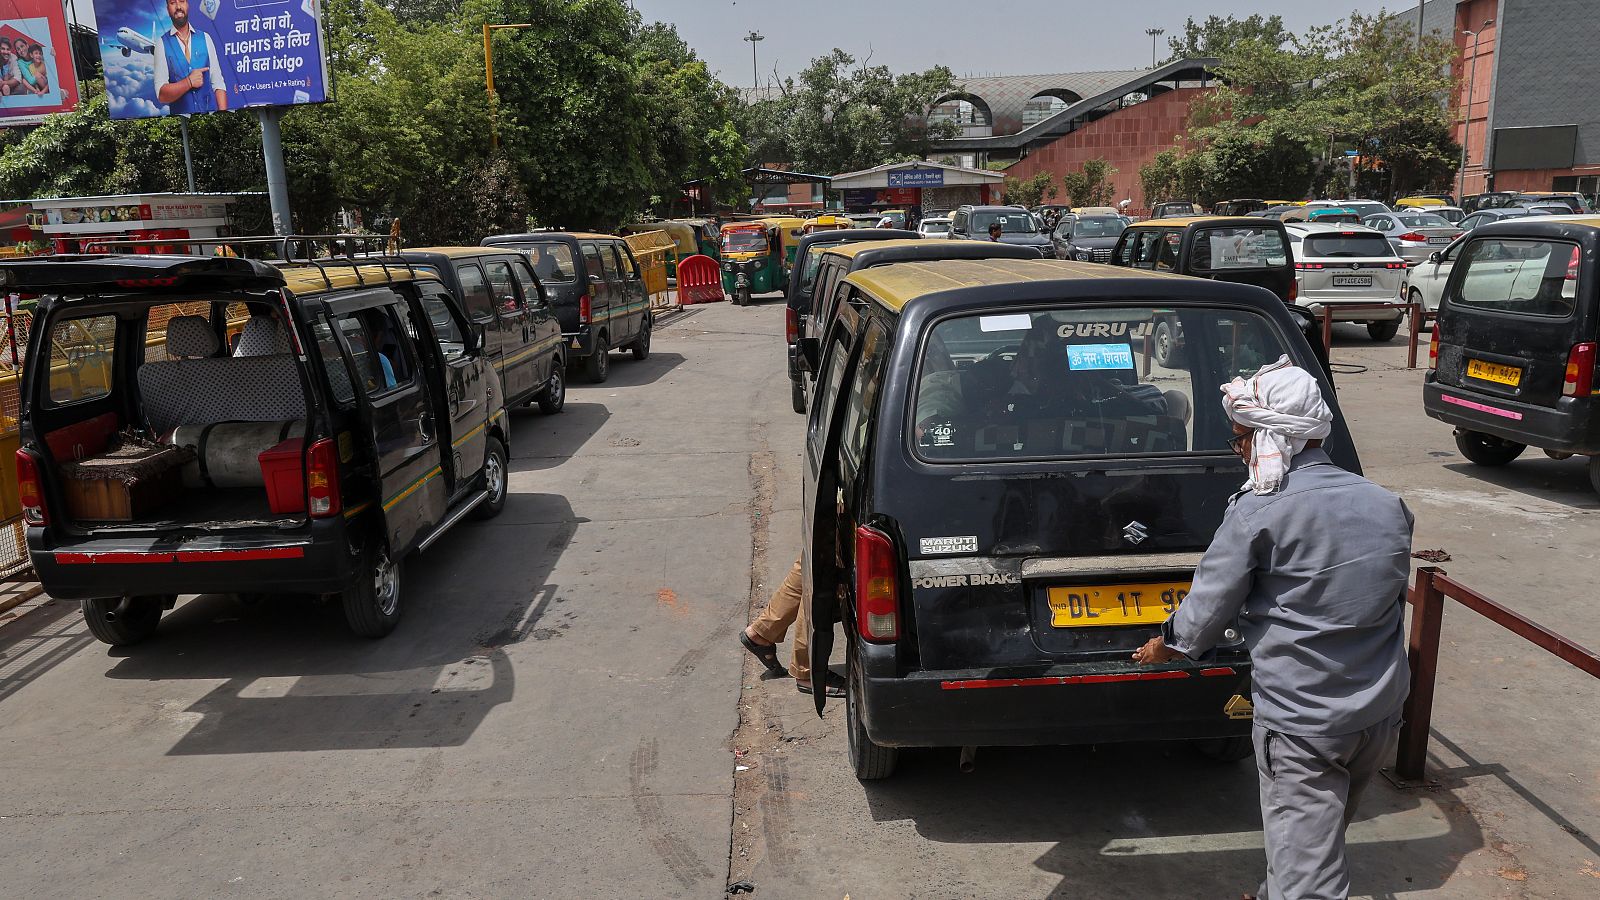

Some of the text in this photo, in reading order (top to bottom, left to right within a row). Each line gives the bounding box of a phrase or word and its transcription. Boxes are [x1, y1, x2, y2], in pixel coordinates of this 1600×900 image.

[235, 20, 249, 33] ना
[251, 15, 260, 31] ये
[262, 17, 276, 30] ना
[225, 30, 311, 55] FLIGHTS के लिए
[237, 54, 303, 72] भी बस ixigo
[255, 82, 271, 90] Users
[288, 79, 306, 87] Rating
[1057, 322, 1154, 338] GURU JI
[1072, 351, 1082, 366] ॐ
[1102, 347, 1129, 365] शिवाय
[1473, 363, 1482, 376] DL
[935, 426, 950, 436] 40
[921, 537, 976, 546] MARUTI
[922, 544, 977, 553] SUZUKI
[911, 575, 968, 589] POWER
[1068, 593, 1100, 619] DL
[1116, 591, 1143, 617] 1T
